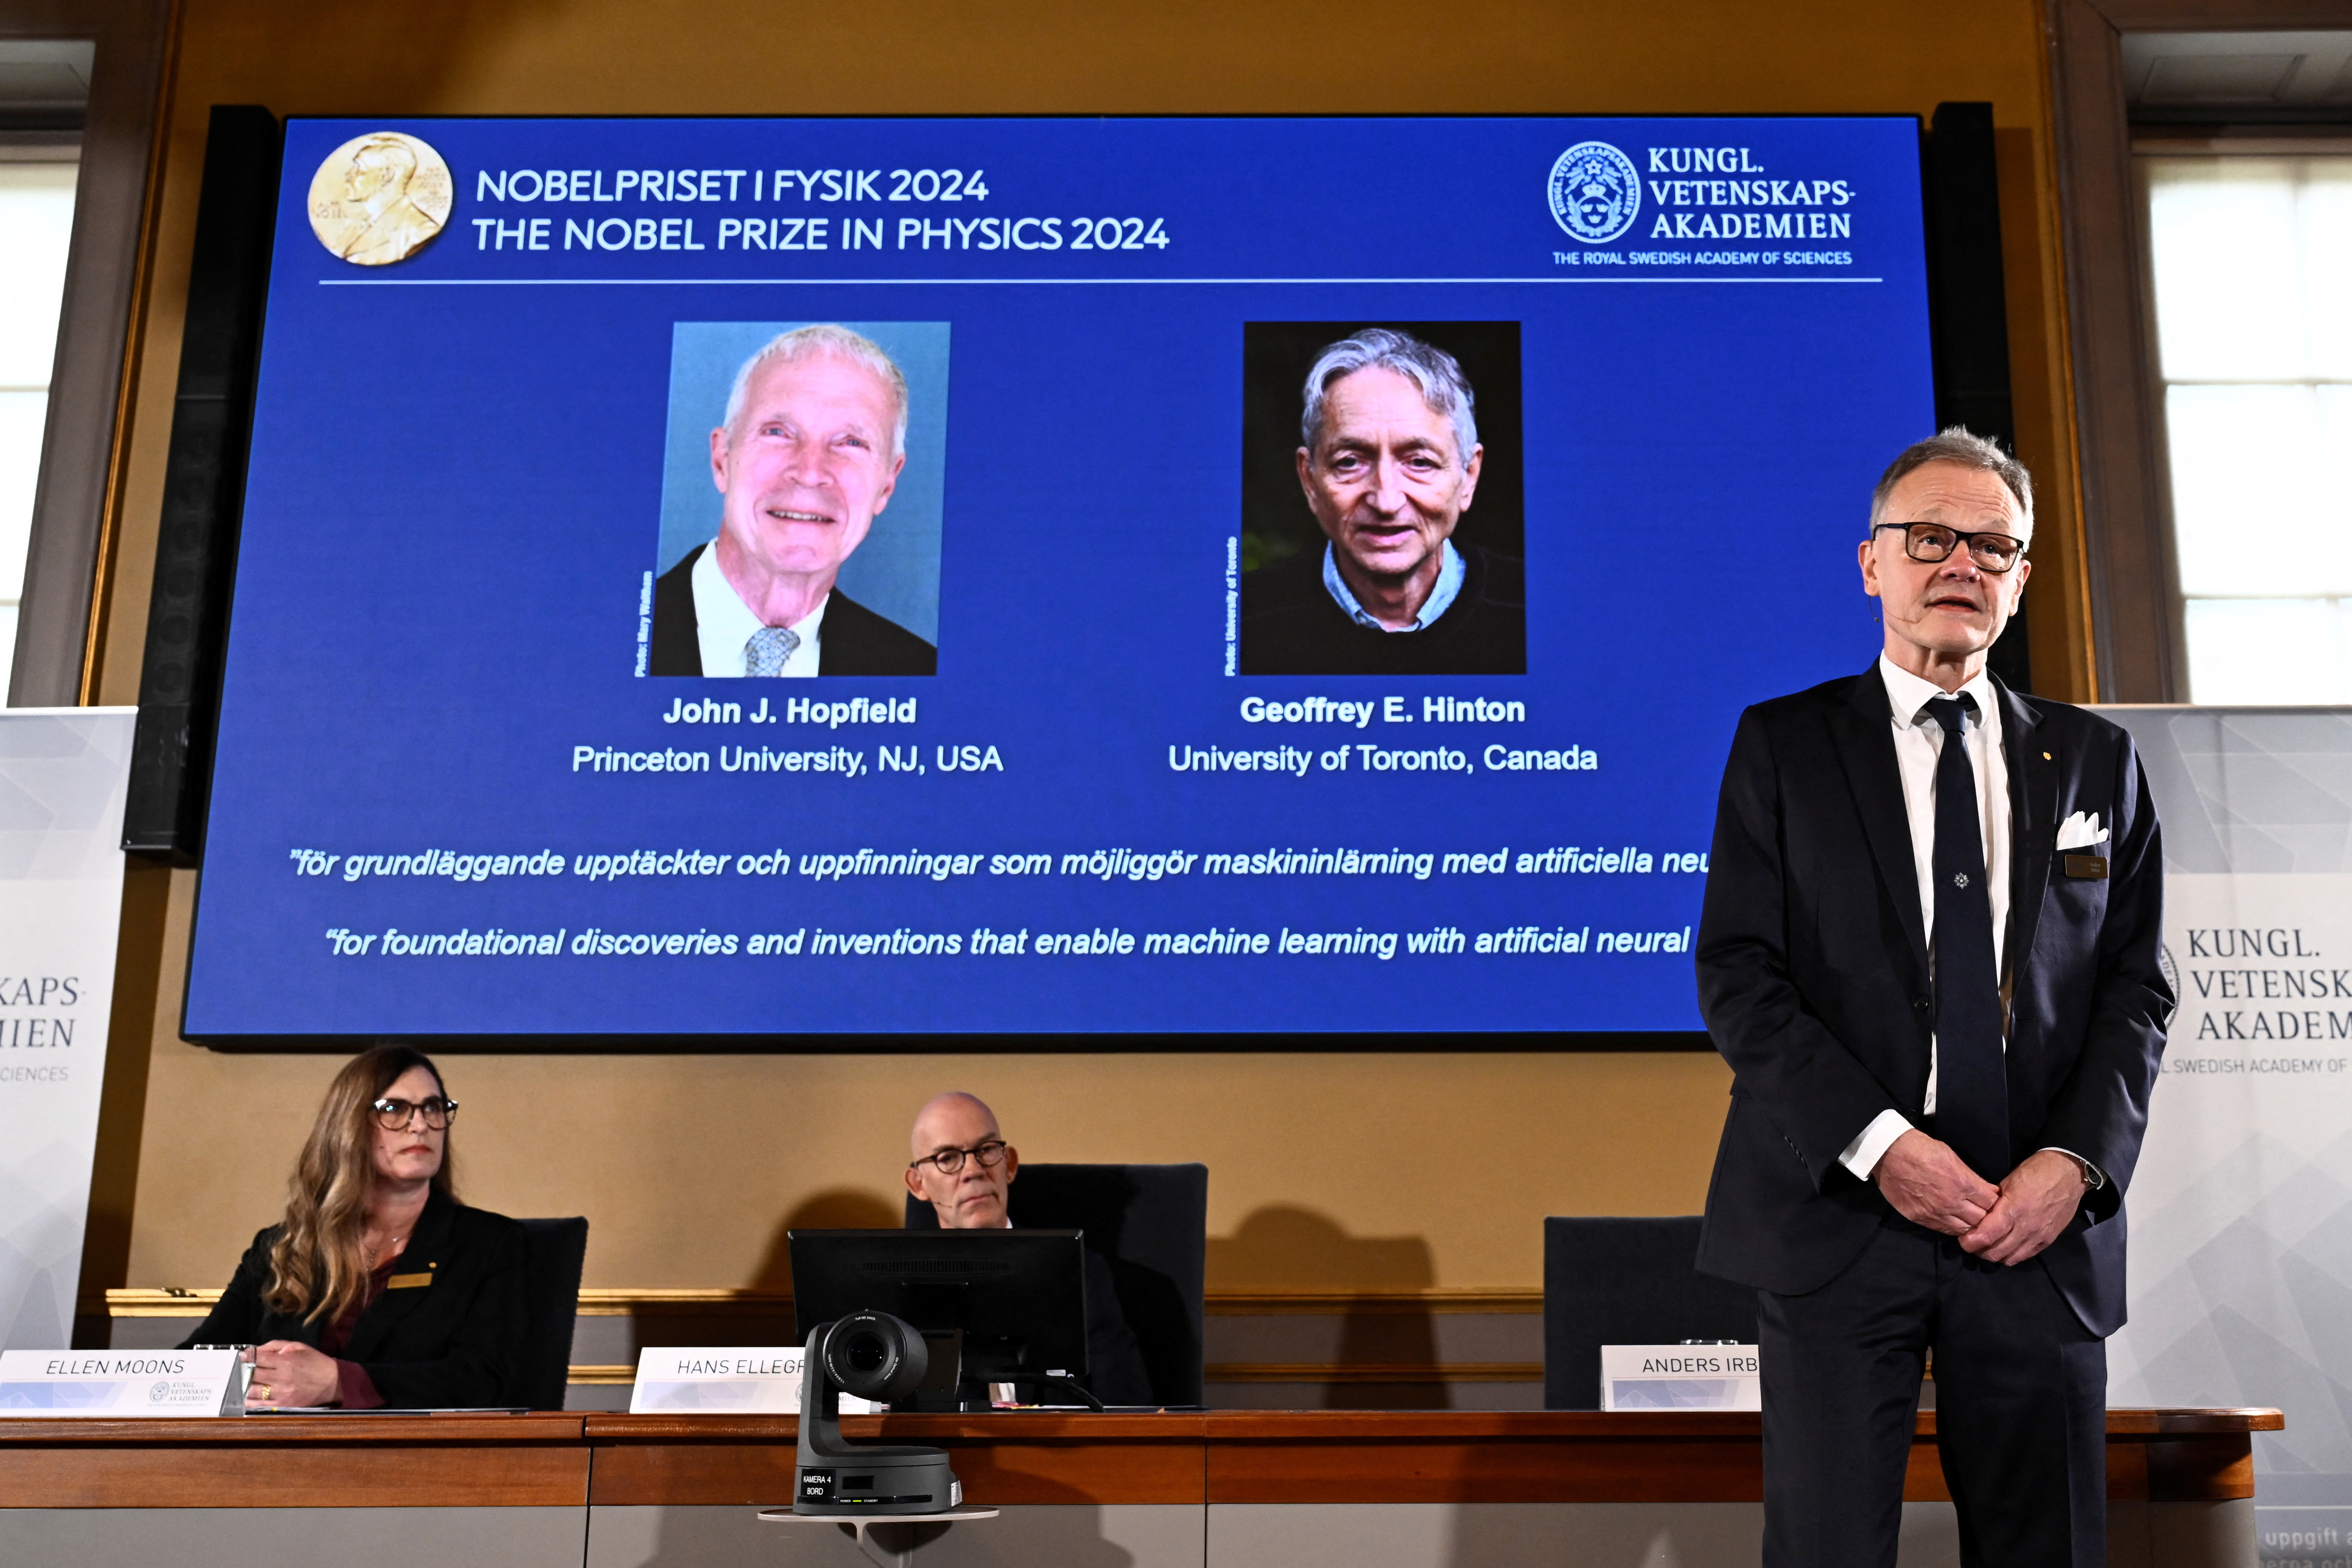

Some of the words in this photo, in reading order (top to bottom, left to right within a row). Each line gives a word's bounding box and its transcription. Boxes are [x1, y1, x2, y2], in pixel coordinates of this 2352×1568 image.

[1648, 147, 1764, 173] KUNGL.
[476, 169, 747, 202] NOBELPRISET
[754, 170, 763, 201] I
[773, 169, 882, 202] FYSIK
[888, 169, 989, 202] 2024
[1648, 180, 1856, 206] VETENSKAPS-
[471, 218, 552, 250] THE
[564, 217, 705, 251] NOBEL
[718, 218, 829, 250] PRIZE
[842, 218, 883, 250] IN
[898, 217, 1063, 250] PHYSICS
[1070, 217, 1170, 250] 2024
[1650, 213, 1851, 239] AKADEMIEN
[1553, 252, 1580, 265] THE
[1583, 252, 1626, 265] ROYAL
[1629, 251, 1691, 265] SWEDISH
[1694, 251, 1760, 265] ACADEMY
[1762, 252, 1780, 265] OF
[1783, 251, 1853, 265] SCIENCES
[1226, 536, 1237, 576] Toronto
[1226, 577, 1237, 589] of
[1225, 590, 1238, 641] University
[663, 698, 741, 724] John
[749, 698, 777, 723] J.
[787, 697, 917, 729] Hopfield
[1240, 696, 1375, 728] Geoffrey
[1384, 696, 1413, 722] E.
[1423, 696, 1525, 722] Hinton
[573, 746, 710, 772] Princeton
[720, 745, 867, 778] University,
[878, 745, 925, 775] NJ,
[937, 745, 1004, 771] USA
[1169, 745, 1313, 777] University
[1320, 745, 1351, 771] of
[1356, 745, 1473, 775] Toronto,
[1484, 744, 1598, 770] Canada
[343, 848, 565, 882] grundläggande
[573, 848, 732, 882] upptäckter
[737, 848, 791, 875] och
[799, 848, 984, 881] uppfinningar
[989, 854, 1052, 875] som
[1060, 848, 1198, 880] möjliggör
[1203, 847, 1434, 880] maskininlärning
[1442, 847, 1509, 873] med
[1515, 847, 1653, 873] artificiella
[381, 928, 566, 955] foundational
[571, 928, 739, 955] discoveries
[746, 928, 806, 955] and
[811, 928, 963, 955] inventions
[970, 928, 1029, 955] that
[1035, 927, 1135, 954] enable
[1143, 927, 1270, 954] machine
[1278, 927, 1398, 960] learning
[1407, 927, 1466, 954] with
[1474, 926, 1589, 953] artificial
[1596, 926, 1691, 953] neural
[2187, 929, 2320, 958] KUNGL.
[2190, 969, 2352, 999] VETENSK
[0, 1019, 76, 1048] IEN
[2197, 1011, 2352, 1040] AKADEM
[2173, 1058, 2245, 1074] SWEDISH
[2249, 1058, 2322, 1073] ACADEMY
[2328, 1058, 2347, 1072] OF
[46, 1360, 110, 1374] ELLEN
[115, 1360, 185, 1374] MOONS
[678, 1360, 729, 1374] HANS
[736, 1360, 805, 1374] ELLEGR
[1642, 1358, 1720, 1372] ANDERS
[1726, 1358, 1758, 1372] IRB
[803, 1475, 826, 1484] KAMERA
[2265, 1527, 2338, 1551] uppgift
